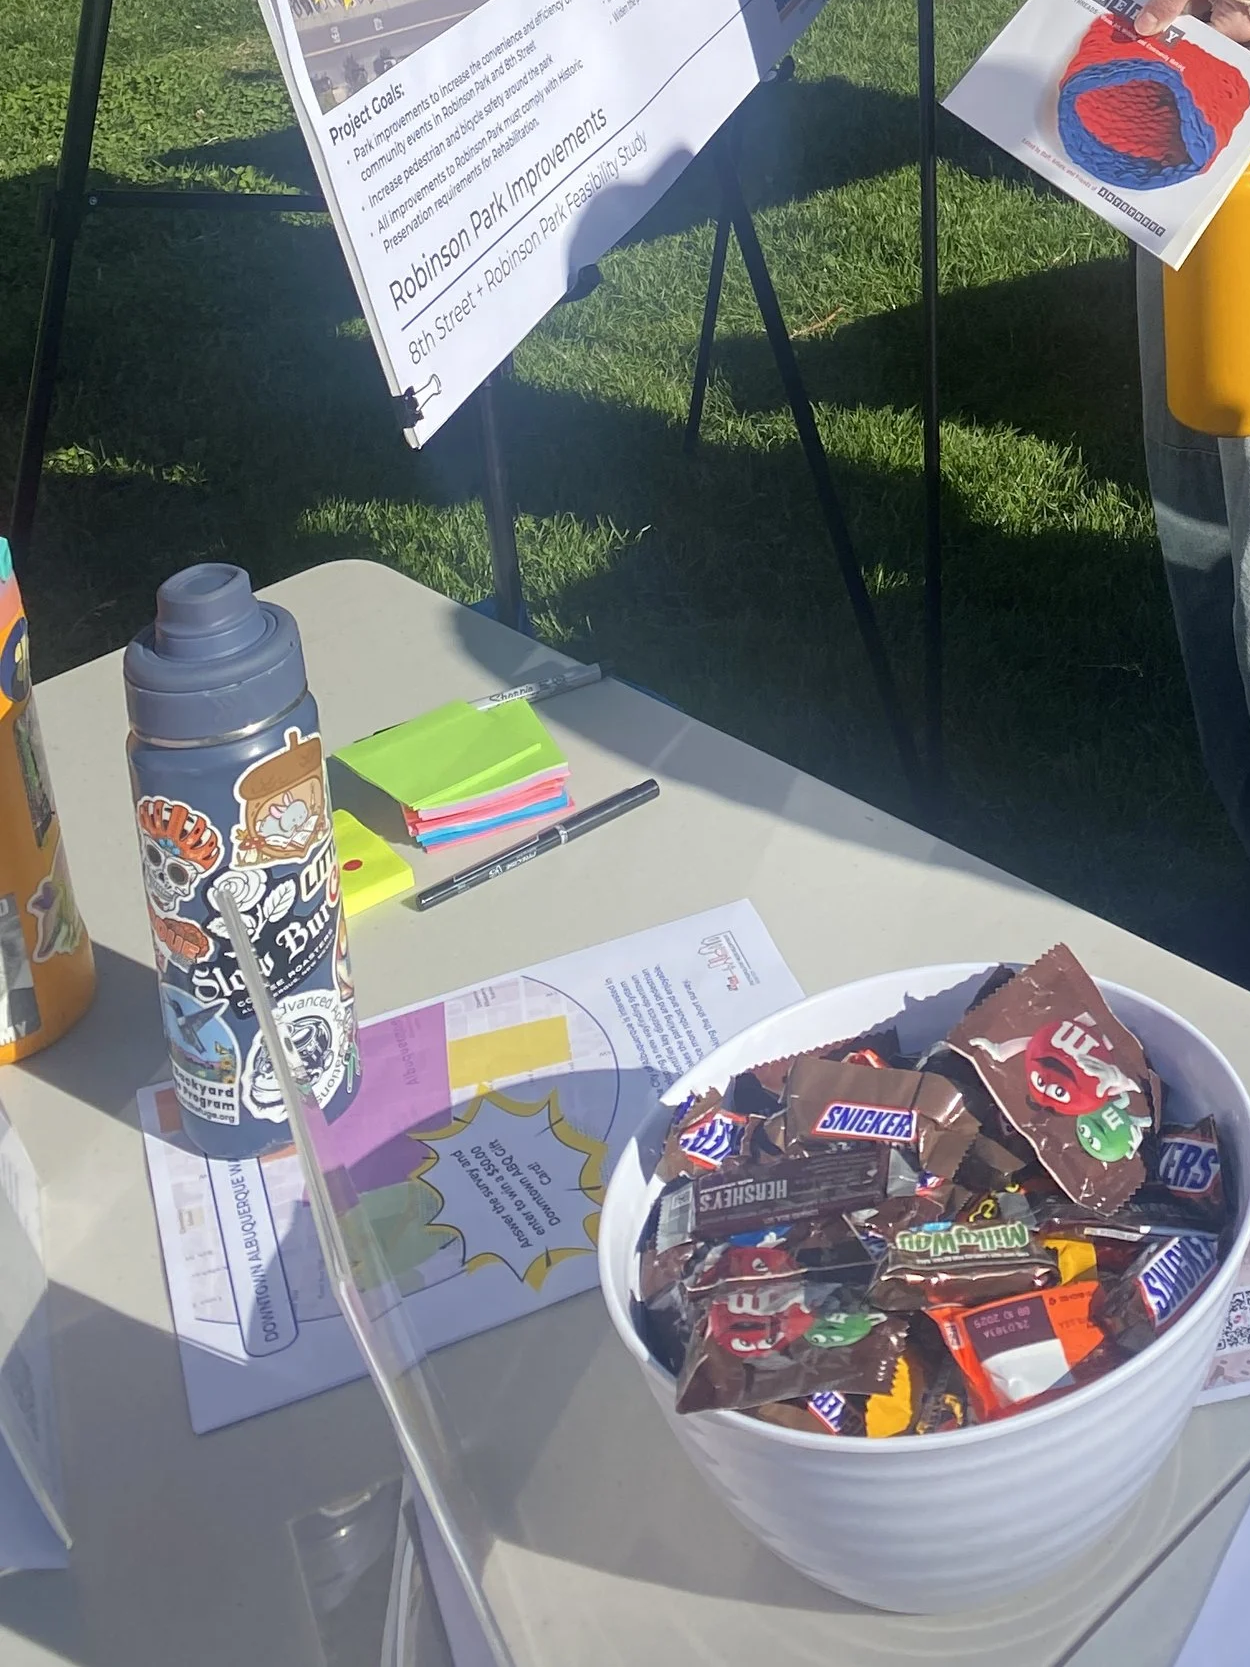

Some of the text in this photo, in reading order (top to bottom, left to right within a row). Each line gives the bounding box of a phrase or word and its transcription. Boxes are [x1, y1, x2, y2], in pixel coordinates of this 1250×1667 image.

[329, 84, 405, 146] Project Goals:
[353, 136, 374, 162] Park
[374, 98, 430, 145] improvements
[429, 90, 440, 106] to
[439, 70, 470, 94] increase
[469, 57, 481, 75] the
[481, 29, 523, 66] convenience
[522, 19, 535, 37] and
[535, 0, 564, 28] efficiency
[361, 40, 537, 182] community events in Robinson Park and 8th Street
[368, 54, 554, 208] Increase pedestrian and bicycle safety around the park
[377, 59, 584, 233] All improvements to Robinson Park must comply with Historic
[383, 118, 539, 253] Preservation requirements for Rehabilitation.
[390, 108, 607, 311] Robinson Park Improvements
[409, 130, 648, 365] 8th Street + Robinson Park Feasibility Study
[275, 901, 329, 963] Bur
[237, 978, 285, 1008] COEE
[276, 995, 333, 1016] dvanced
[183, 1086, 234, 1110] Program
[450, 1150, 533, 1248] Answer the survey and
[471, 1146, 545, 1236] enter to win a $50.00
[489, 1139, 561, 1226] Downtown ABQ Gift
[527, 1162, 552, 1185] Card!
[700, 1179, 788, 1212] HERSHEY'S
[231, 1175, 260, 1262] ALBUQUERQUE
[251, 1267, 279, 1342] DOWNTOWN
[1140, 1235, 1217, 1320] SNICKE
